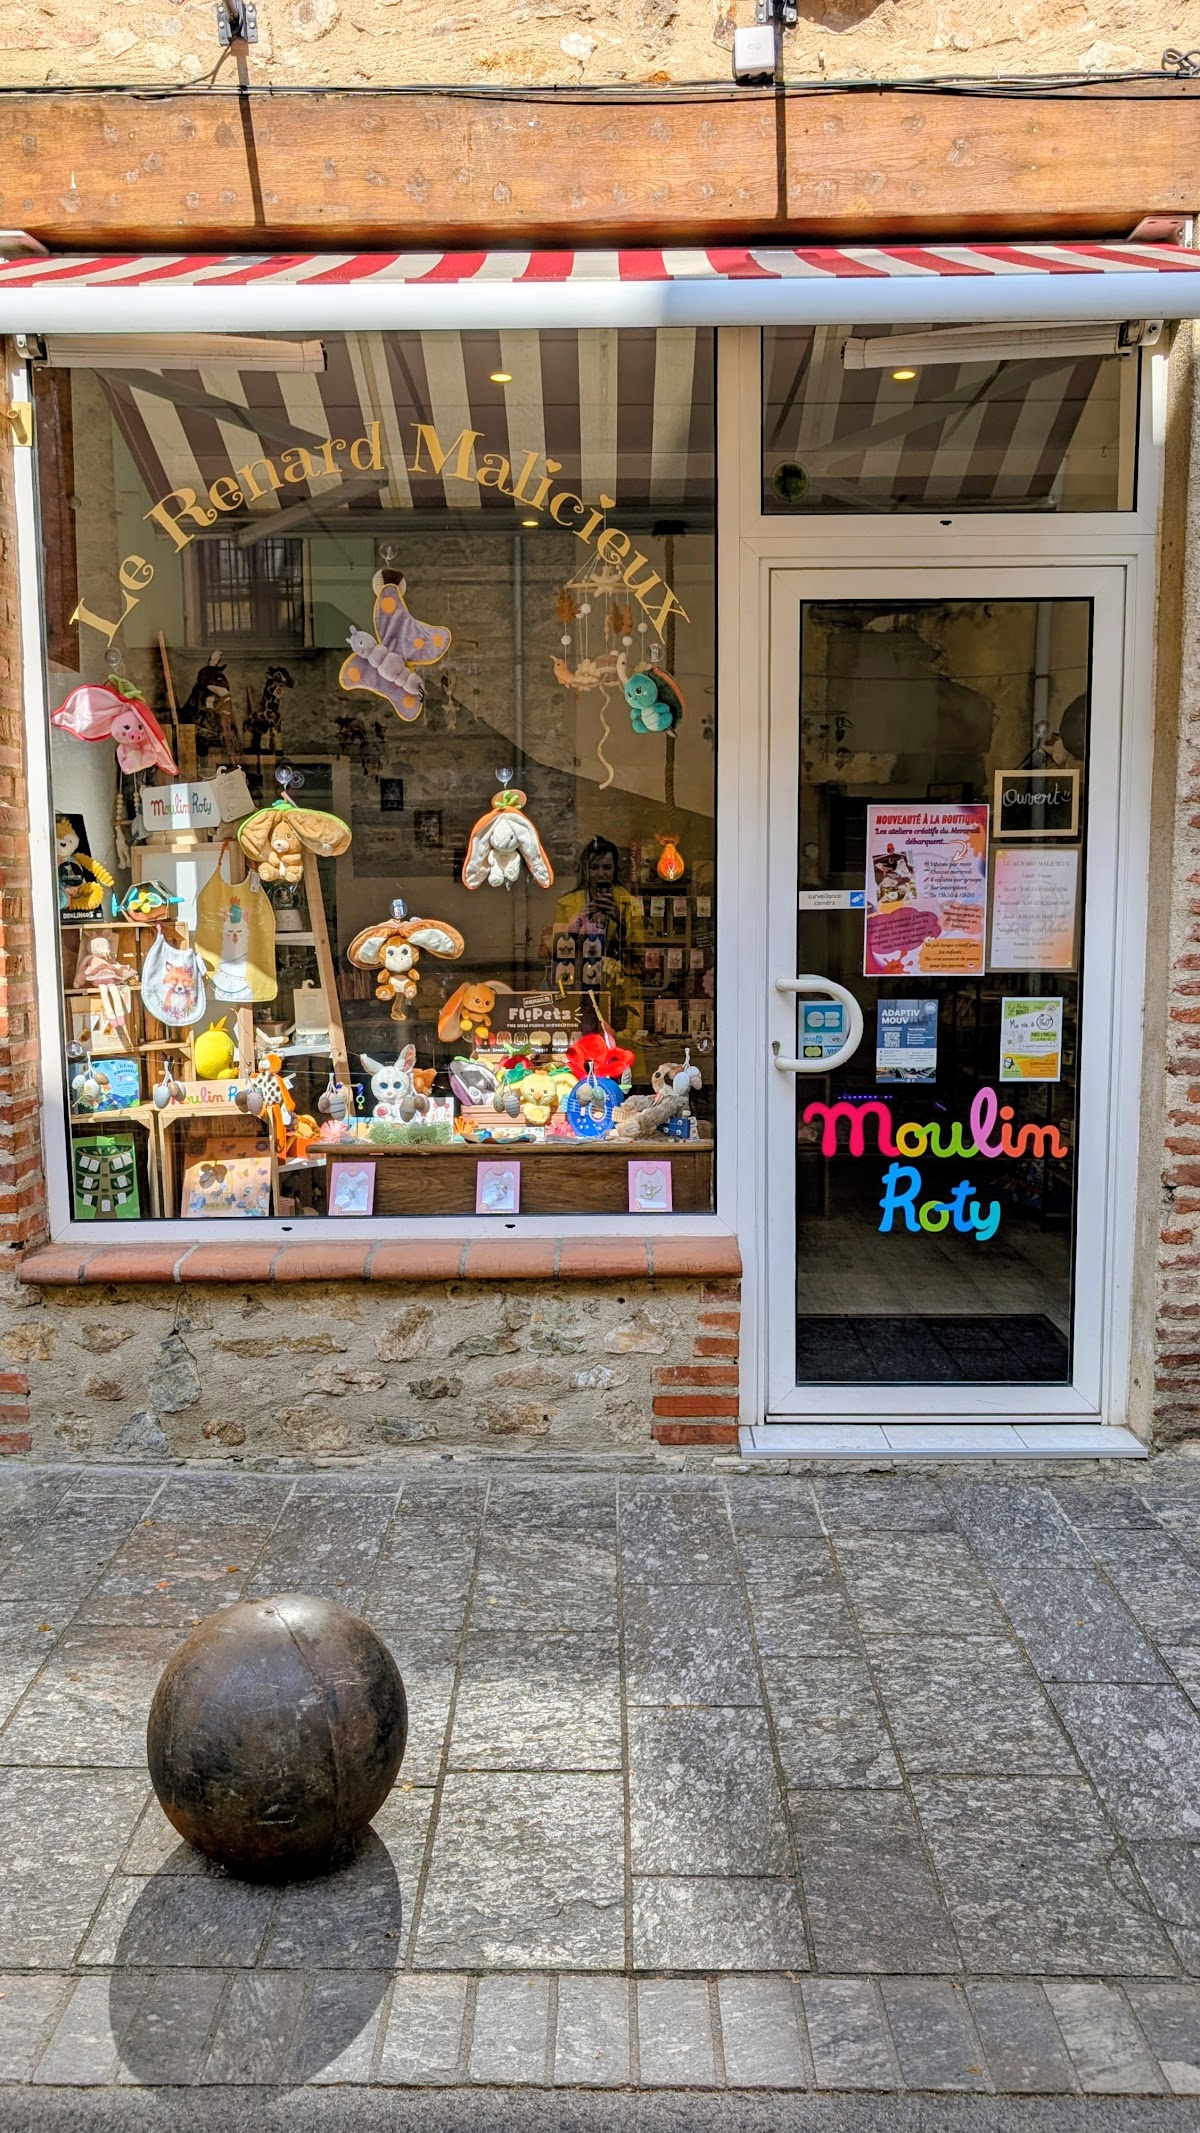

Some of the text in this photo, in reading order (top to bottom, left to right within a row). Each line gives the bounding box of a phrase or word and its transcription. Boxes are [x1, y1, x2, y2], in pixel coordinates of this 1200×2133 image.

[69, 421, 691, 647] Le Renard Malicieux
[150, 792, 211, 816] Moulin Roty
[1003, 782, 1060, 807] Ouvert
[876, 813, 921, 825] NOUVEAUTÉ
[929, 815, 940, 824] LA
[913, 827, 938, 836] créatifs
[881, 1009, 920, 1017] ADAPTIV
[803, 1086, 1068, 1158] Moulin
[878, 1162, 1001, 1241] Roty
